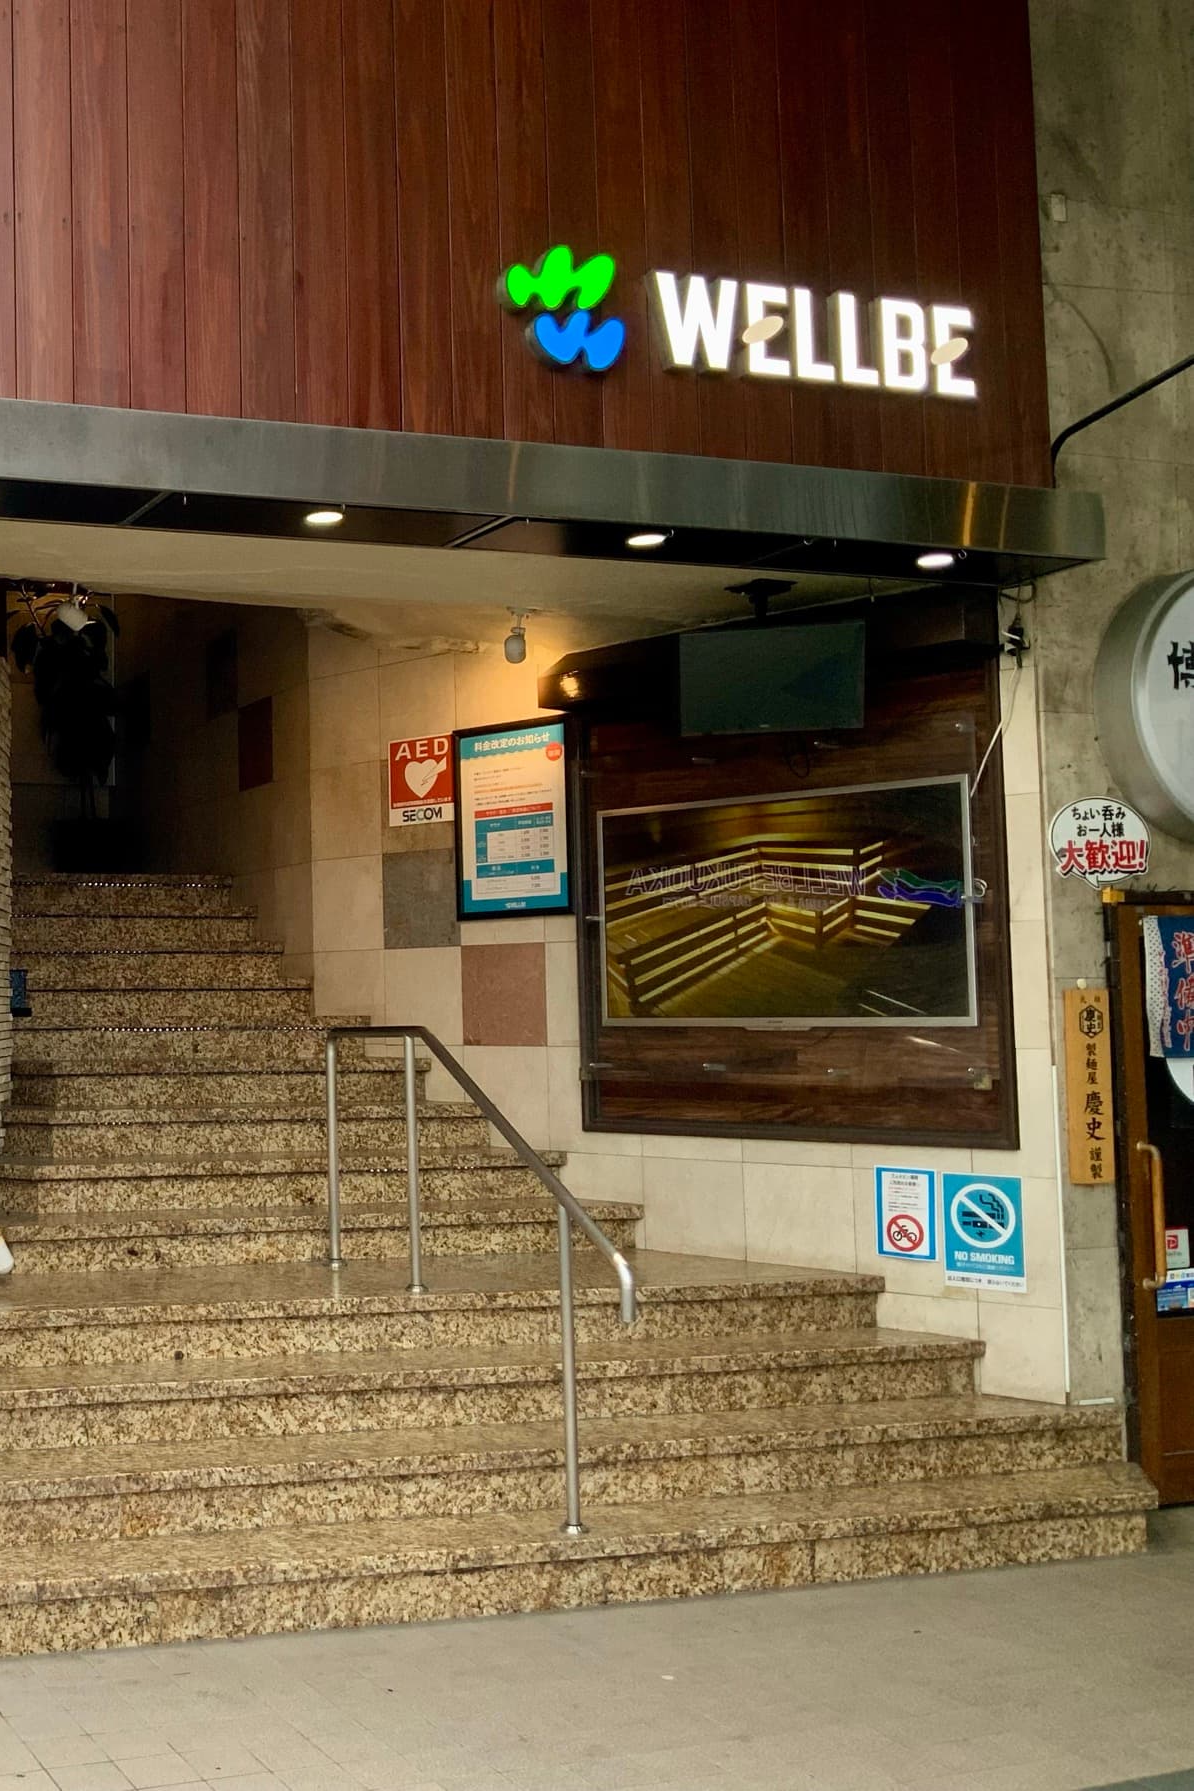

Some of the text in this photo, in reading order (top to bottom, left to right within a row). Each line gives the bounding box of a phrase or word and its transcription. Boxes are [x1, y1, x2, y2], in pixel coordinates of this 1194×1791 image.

[646, 269, 977, 399] WELLBE
[395, 737, 449, 761] AED
[474, 731, 550, 752] 料金改定のお知らせ
[402, 807, 442, 823] SECOM
[1071, 805, 1126, 821] ちょい呑み
[1076, 822, 1125, 837] お一人様
[954, 1250, 1015, 1265] NO SMOKING
